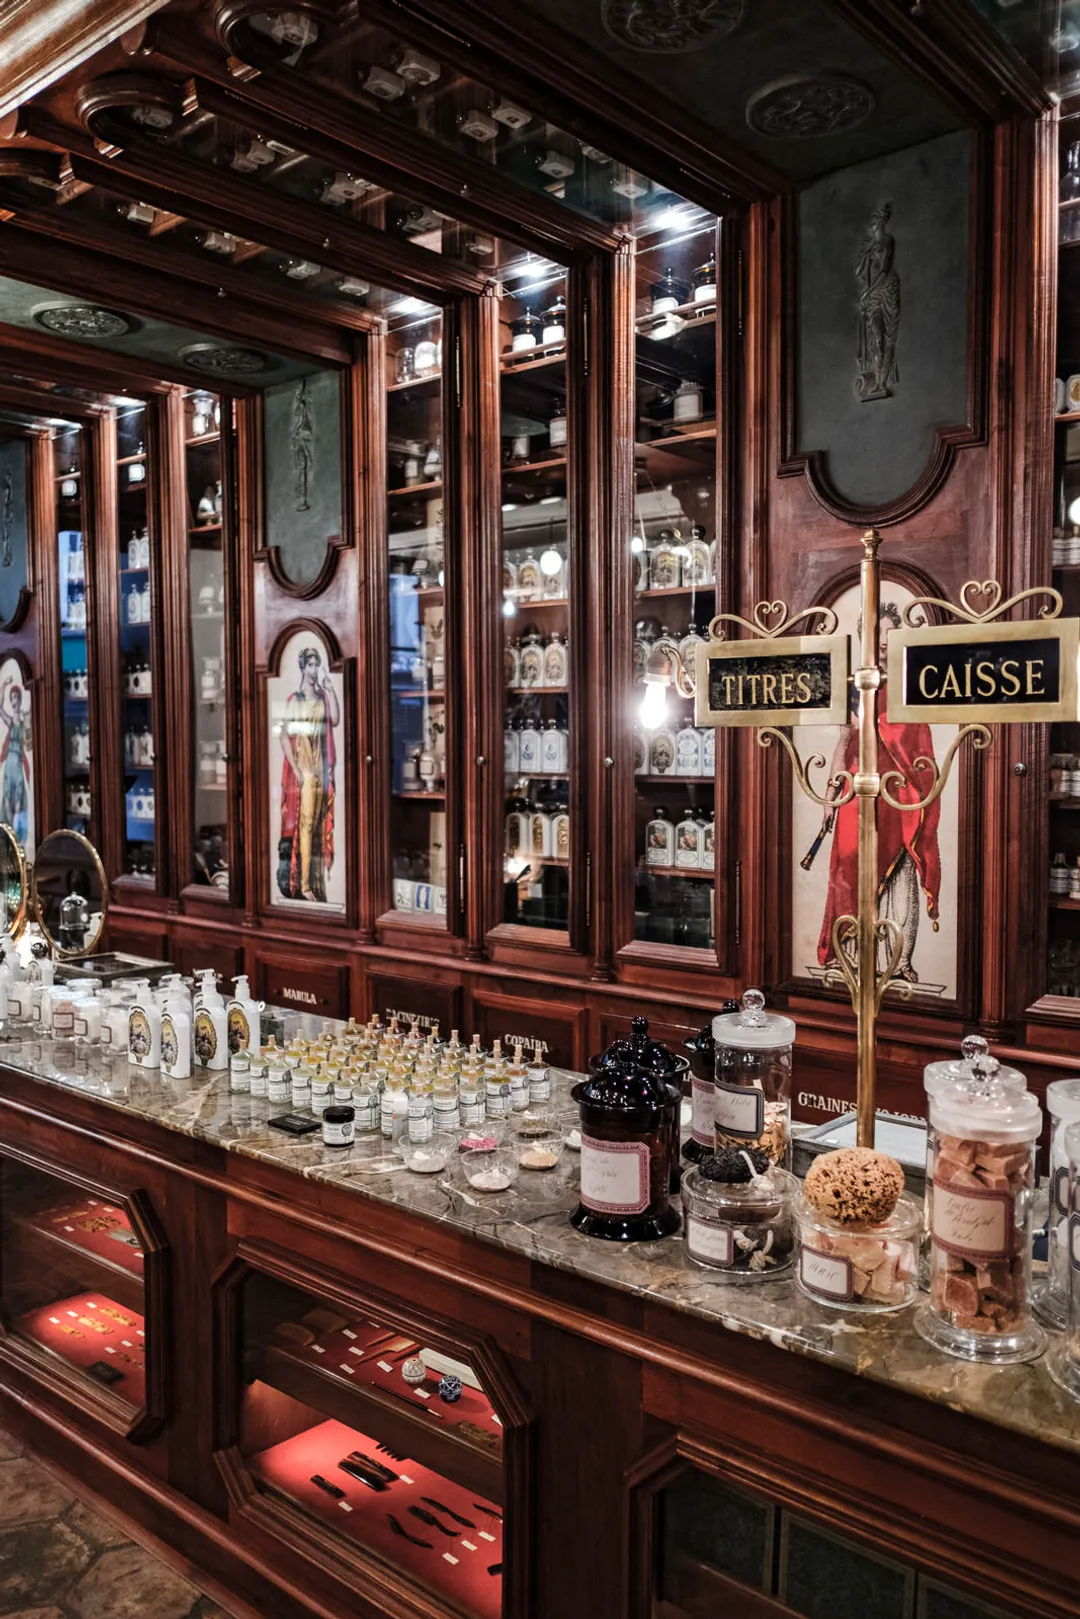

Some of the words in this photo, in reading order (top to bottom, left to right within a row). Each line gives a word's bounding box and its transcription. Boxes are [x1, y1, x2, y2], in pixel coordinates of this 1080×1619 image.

[721, 672, 812, 706] TITRES
[918, 659, 1046, 699] CAISSE
[283, 987, 318, 1005] MARULA
[797, 1091, 859, 1115] GRAINES
